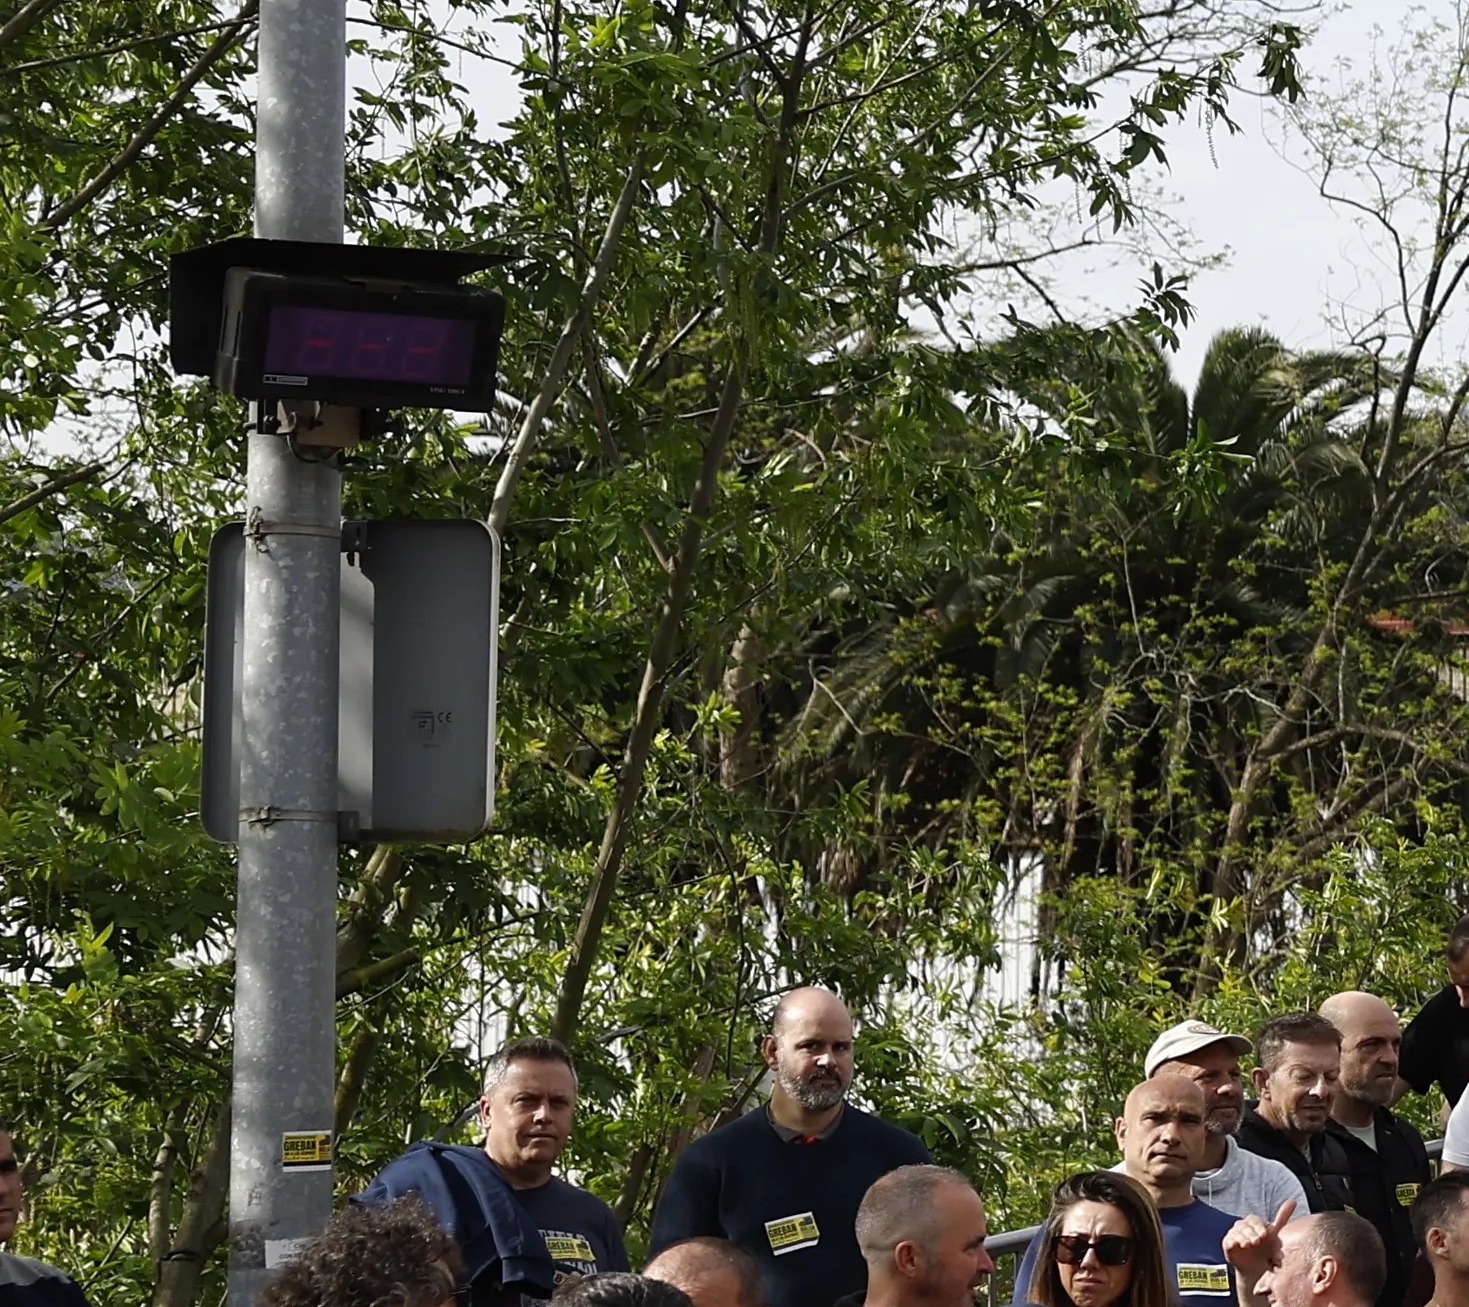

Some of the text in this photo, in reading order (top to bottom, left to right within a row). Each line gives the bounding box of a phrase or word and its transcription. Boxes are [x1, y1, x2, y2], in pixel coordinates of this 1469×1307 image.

[284, 1140, 316, 1152] GREBAN
[768, 1223, 797, 1238] GREBAN
[1178, 1270, 1208, 1280] GREBAN
